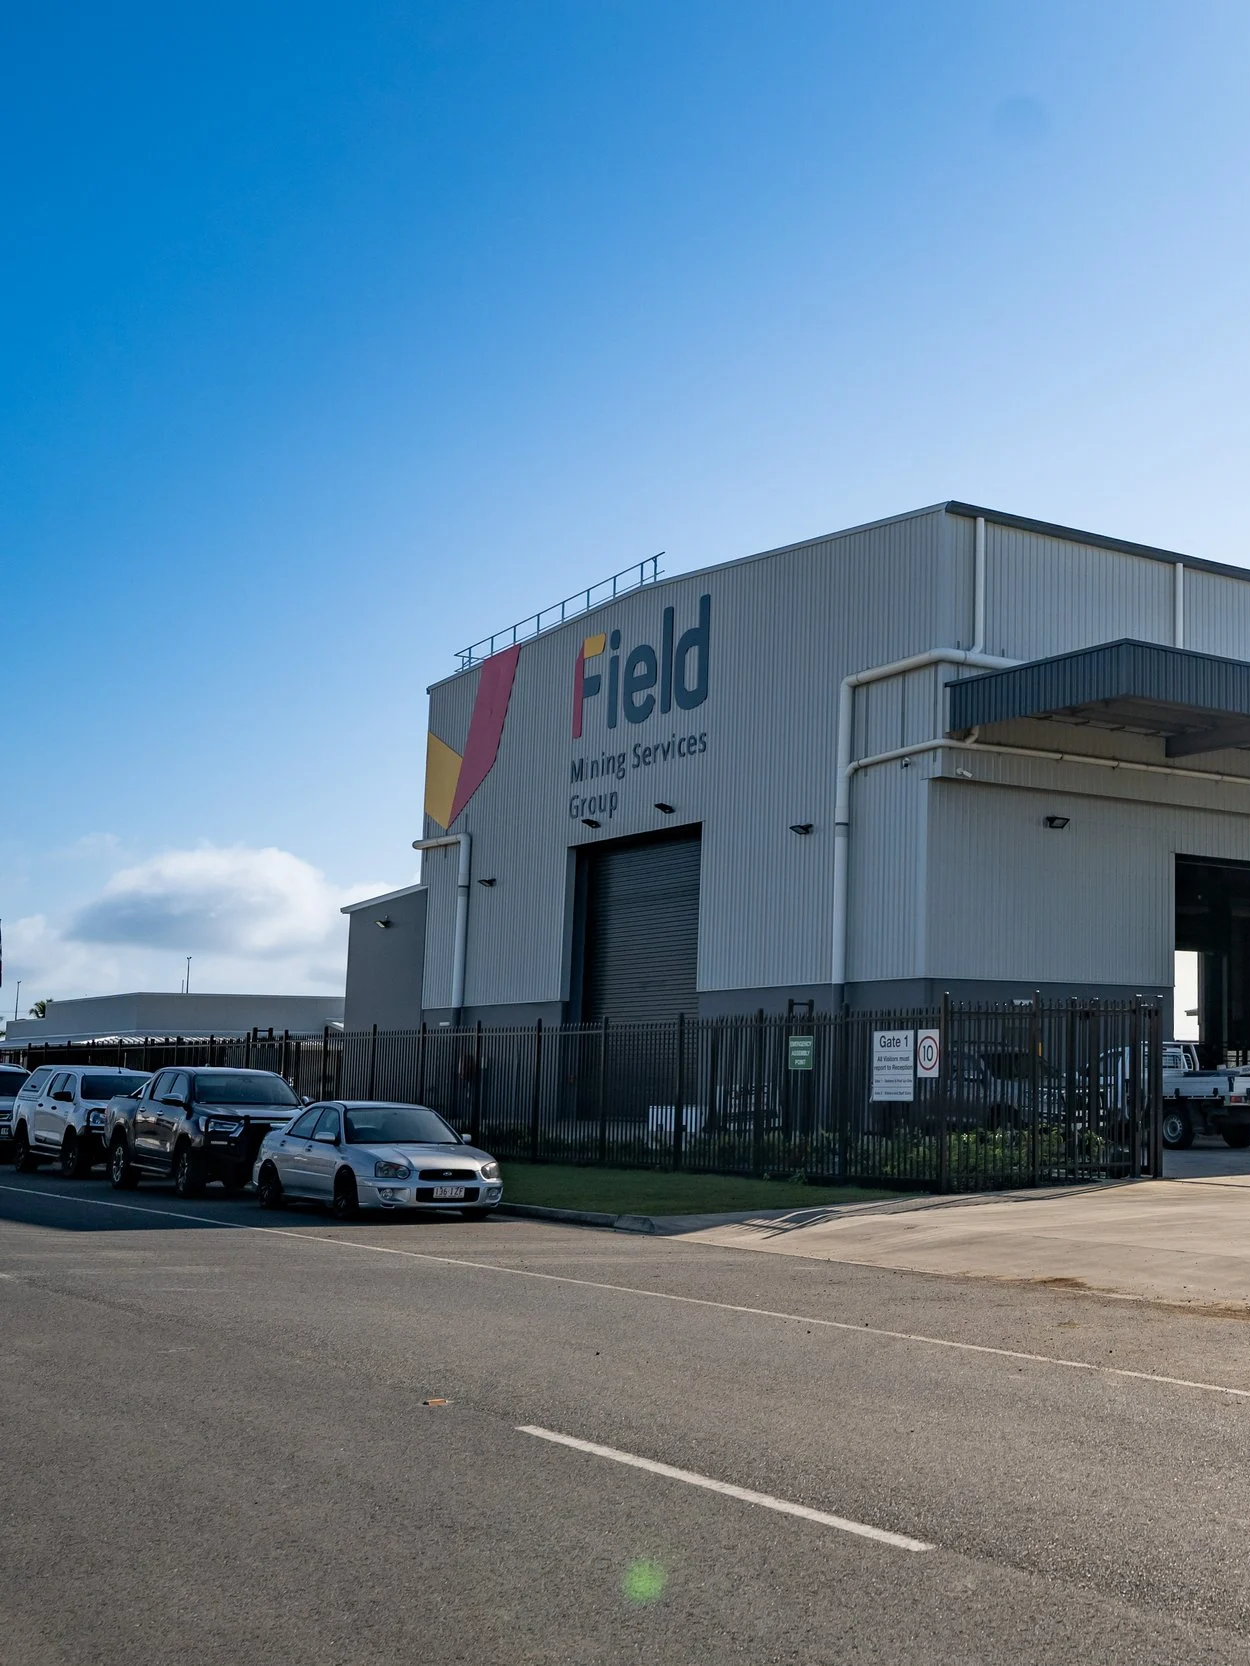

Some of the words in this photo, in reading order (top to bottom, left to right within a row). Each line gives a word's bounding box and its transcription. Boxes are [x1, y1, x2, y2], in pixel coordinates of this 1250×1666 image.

[571, 593, 711, 740] Field
[570, 751, 627, 784] Mining
[631, 731, 707, 770] Services
[568, 791, 618, 819] Group
[879, 1035, 901, 1048] Gate
[903, 1034, 909, 1048] 1
[922, 1044, 934, 1062] 10
